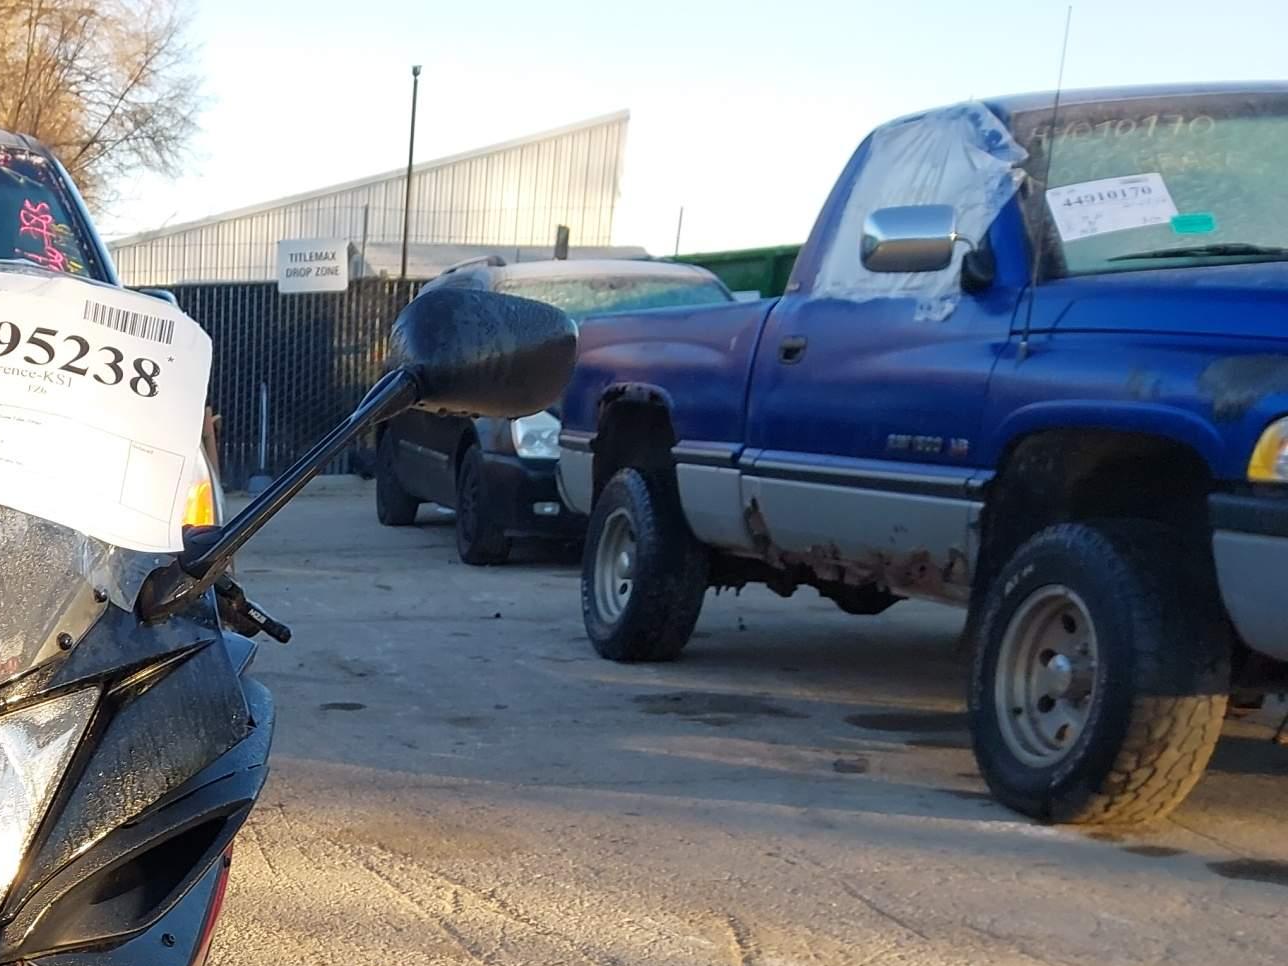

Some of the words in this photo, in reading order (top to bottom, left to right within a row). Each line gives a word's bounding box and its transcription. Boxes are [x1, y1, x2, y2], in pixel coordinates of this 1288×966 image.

[288, 251, 336, 262] TITLEMAX
[286, 266, 312, 278] DROP
[315, 265, 339, 277] ZONE
